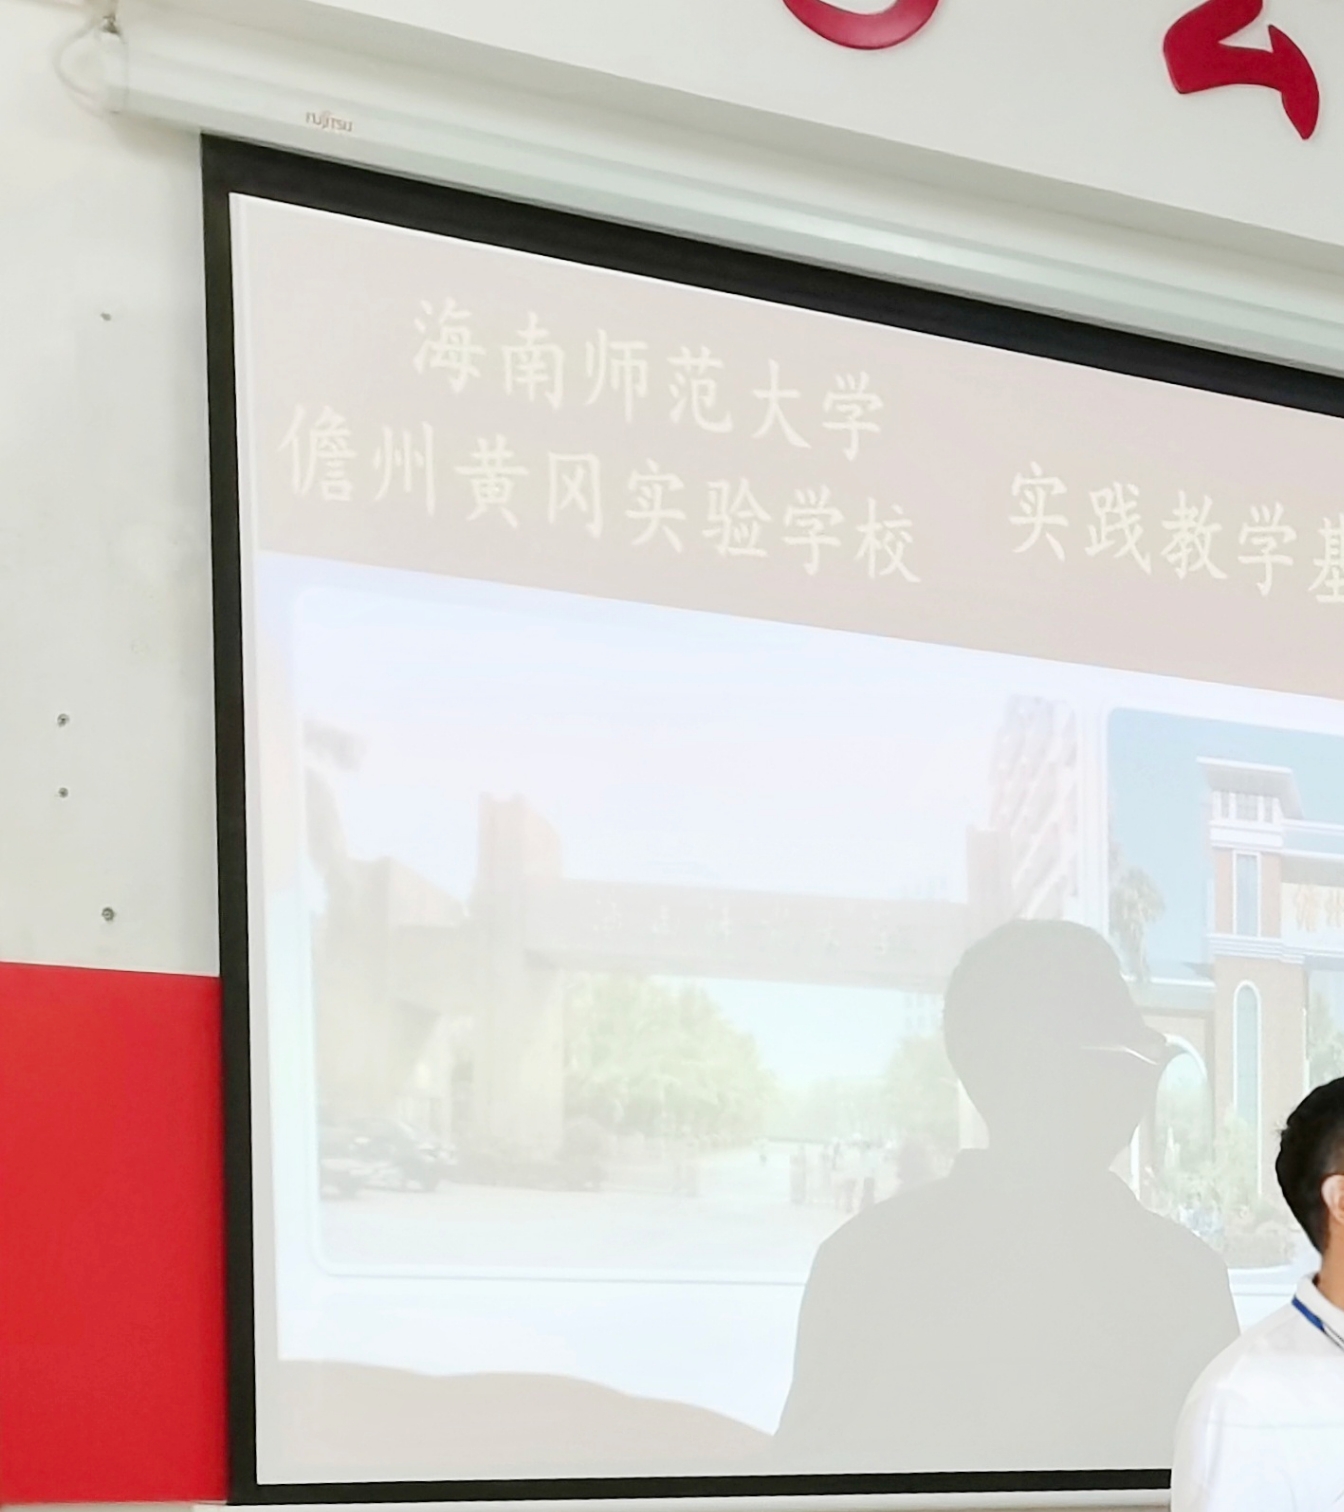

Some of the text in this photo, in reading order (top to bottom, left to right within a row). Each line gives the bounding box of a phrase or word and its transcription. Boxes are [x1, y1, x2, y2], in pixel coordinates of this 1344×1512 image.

[410, 295, 884, 462] 海南师范大学
[277, 403, 922, 585] 儋州黄冈实验学校
